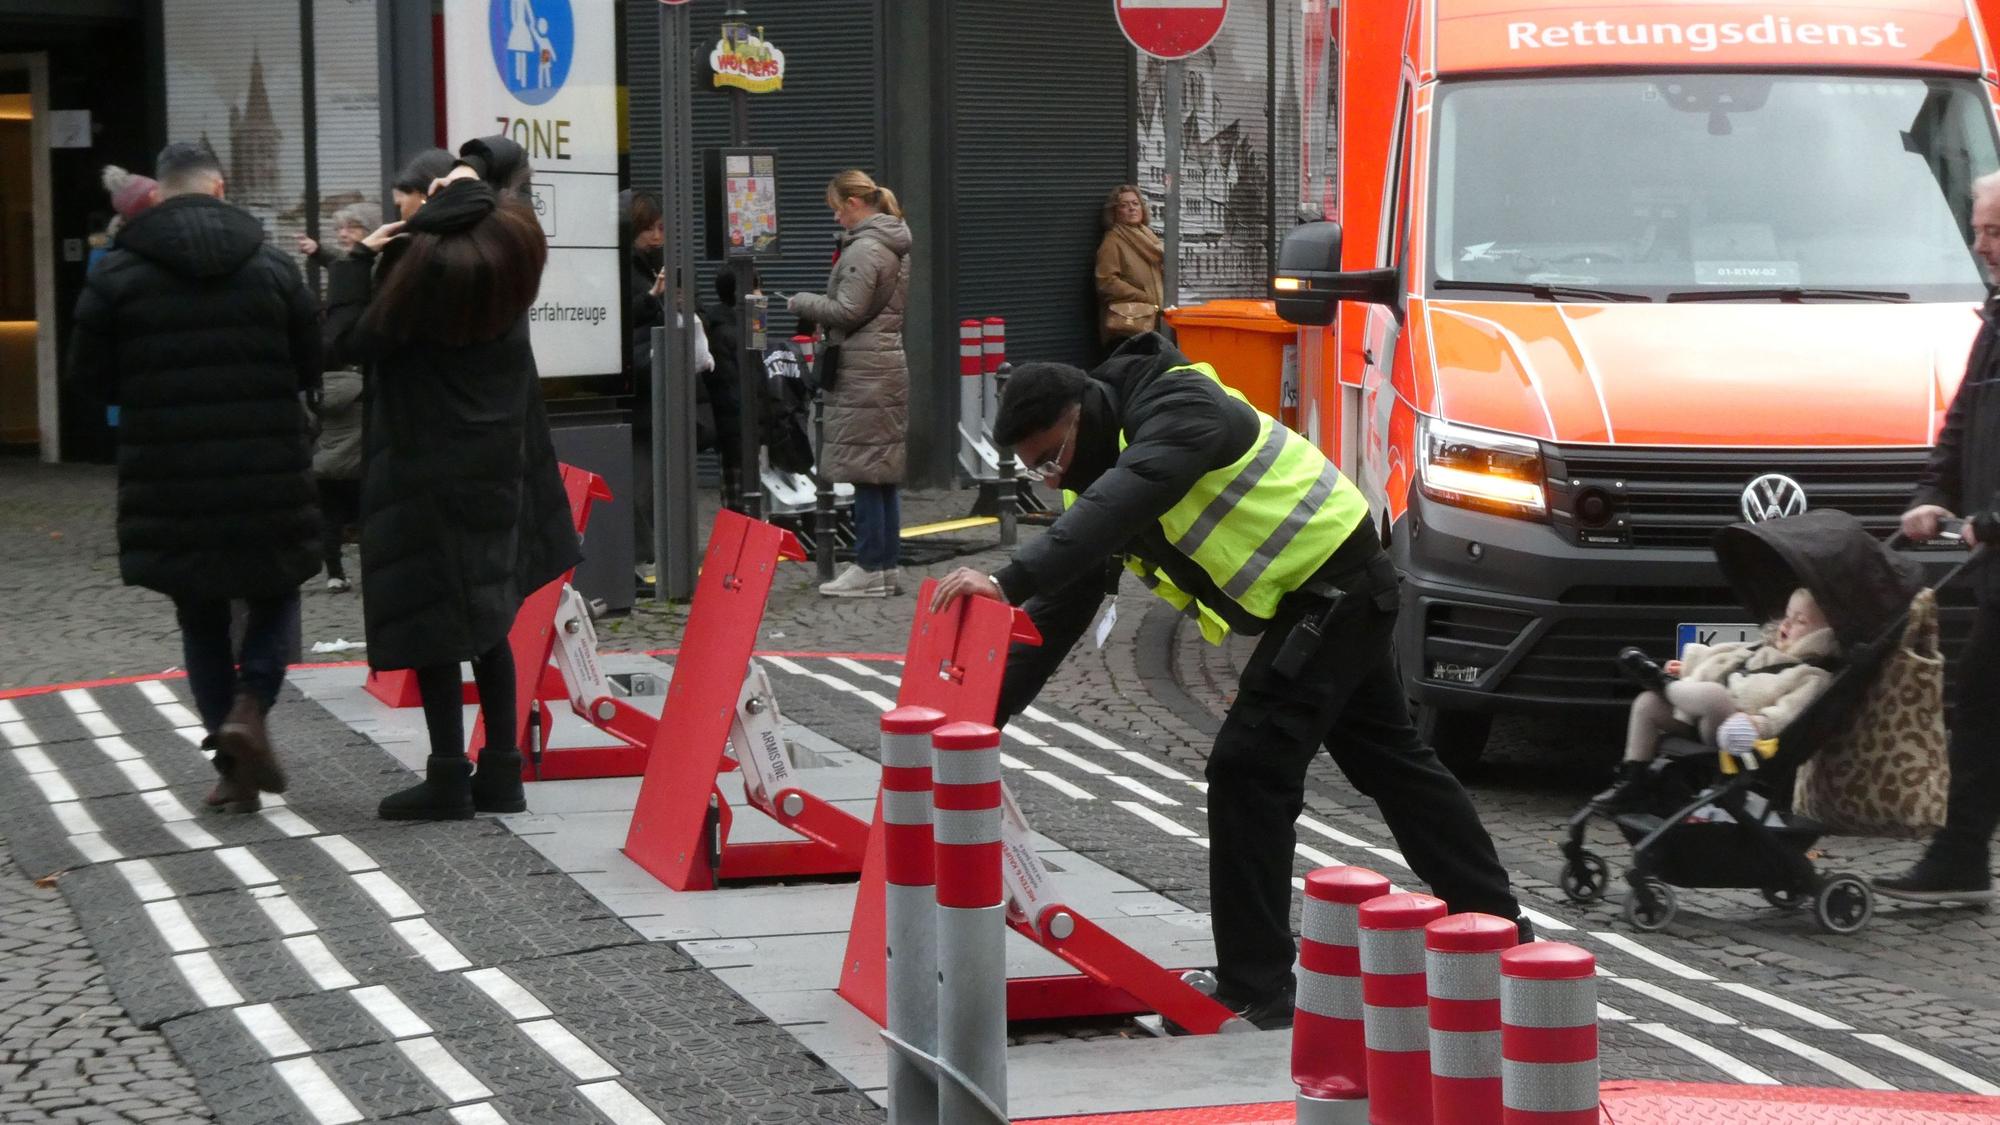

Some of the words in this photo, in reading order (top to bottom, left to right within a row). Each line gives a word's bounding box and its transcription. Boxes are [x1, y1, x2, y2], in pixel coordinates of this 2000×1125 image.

[1507, 15, 1907, 52] Rettungsdienst
[761, 730, 781, 762] ARMIS
[772, 760, 788, 781] ONE
